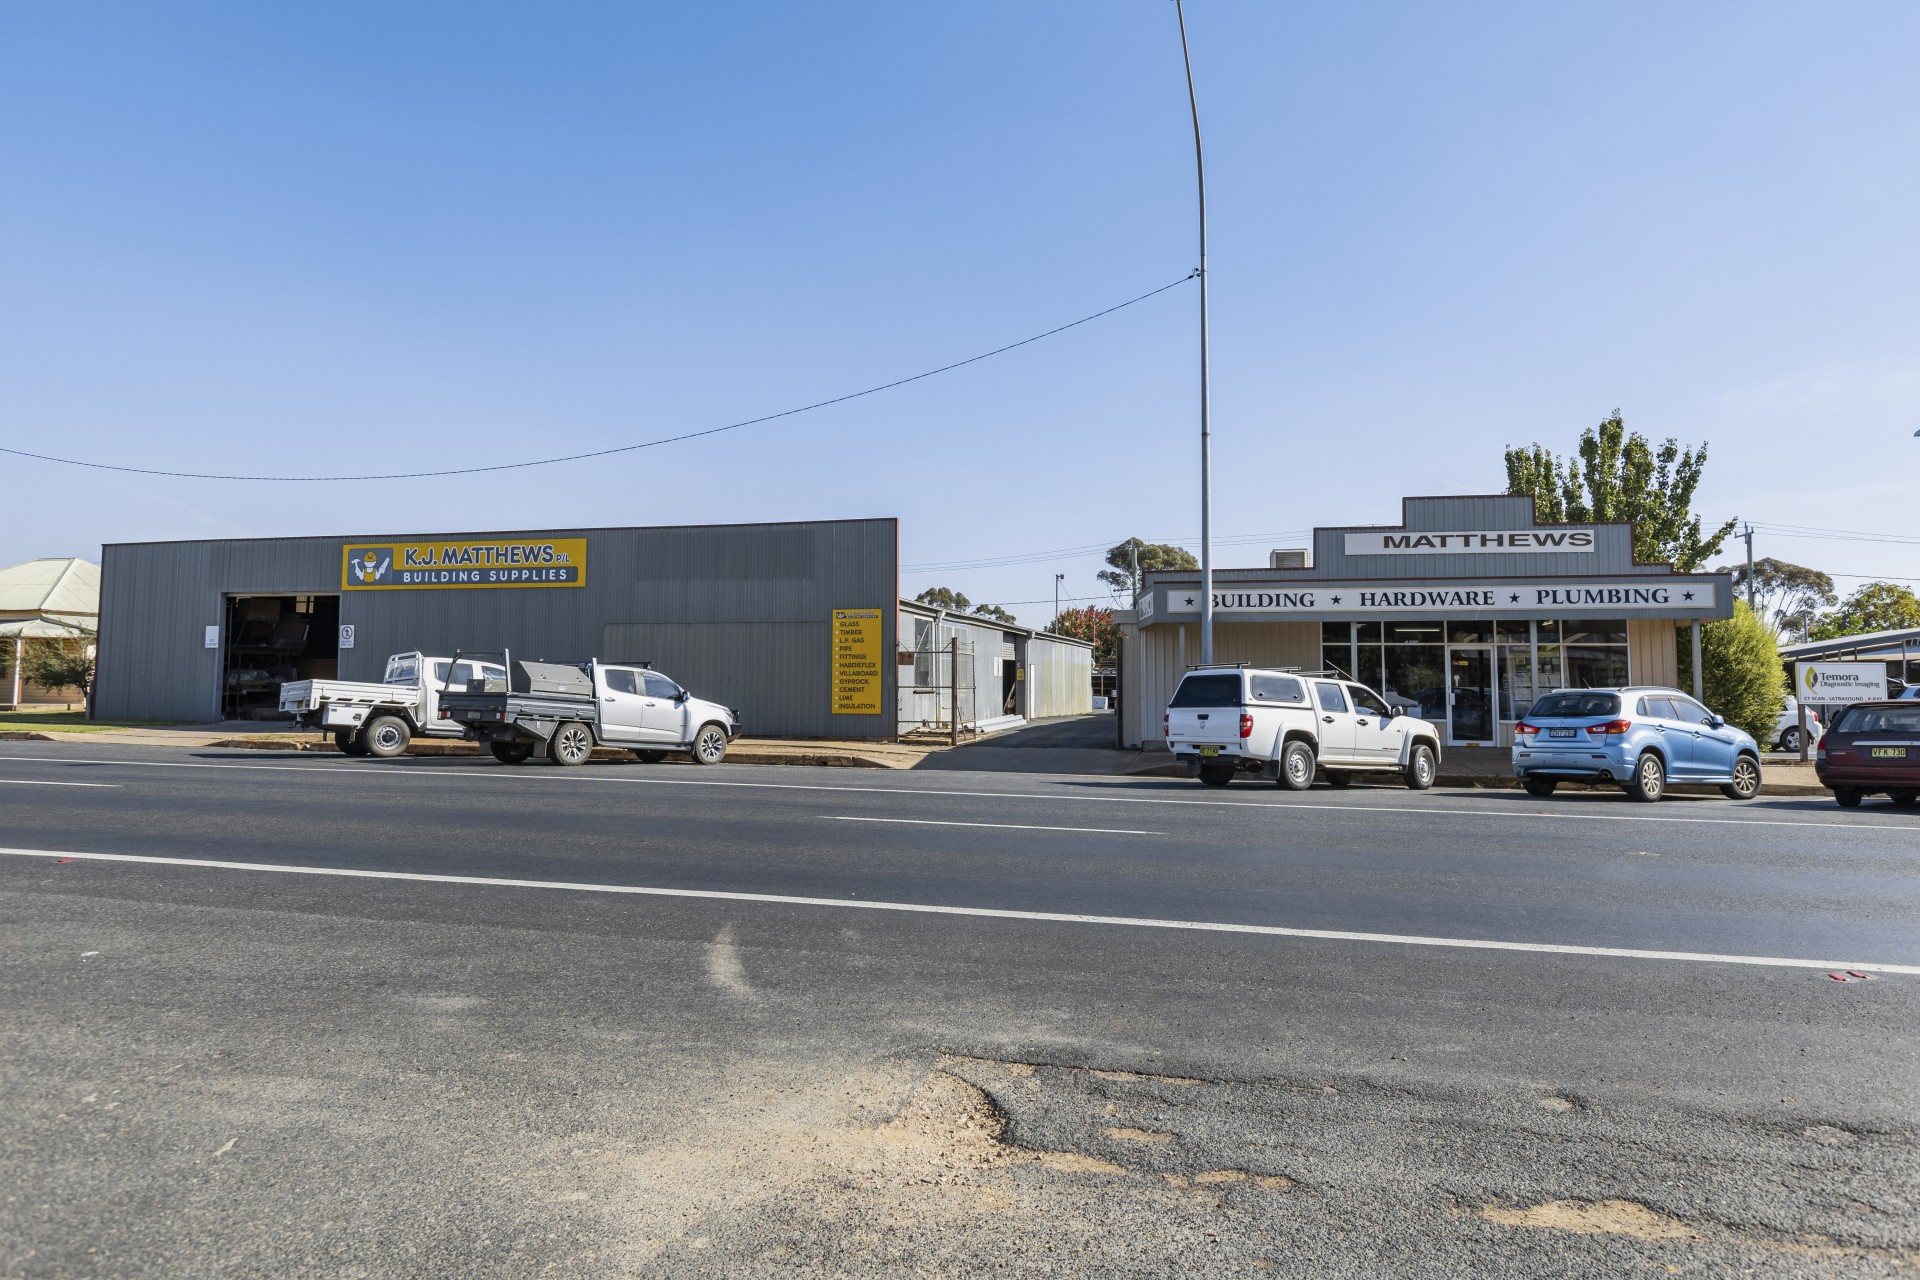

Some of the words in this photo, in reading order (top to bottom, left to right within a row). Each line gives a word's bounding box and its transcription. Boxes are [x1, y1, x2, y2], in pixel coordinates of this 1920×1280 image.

[1383, 532, 1593, 549] MATTHEWS
[404, 546, 438, 567] K.J.
[440, 544, 554, 566] MATTHEWS
[556, 552, 571, 564] P/L
[403, 571, 480, 583] BUILDING
[489, 568, 567, 581] SUPPLIES
[1359, 590, 1495, 607] HARDWARE
[1536, 587, 1669, 605] PLUMBING
[1819, 672, 1859, 681] Temora
[1820, 680, 1853, 688] Diagnostic
